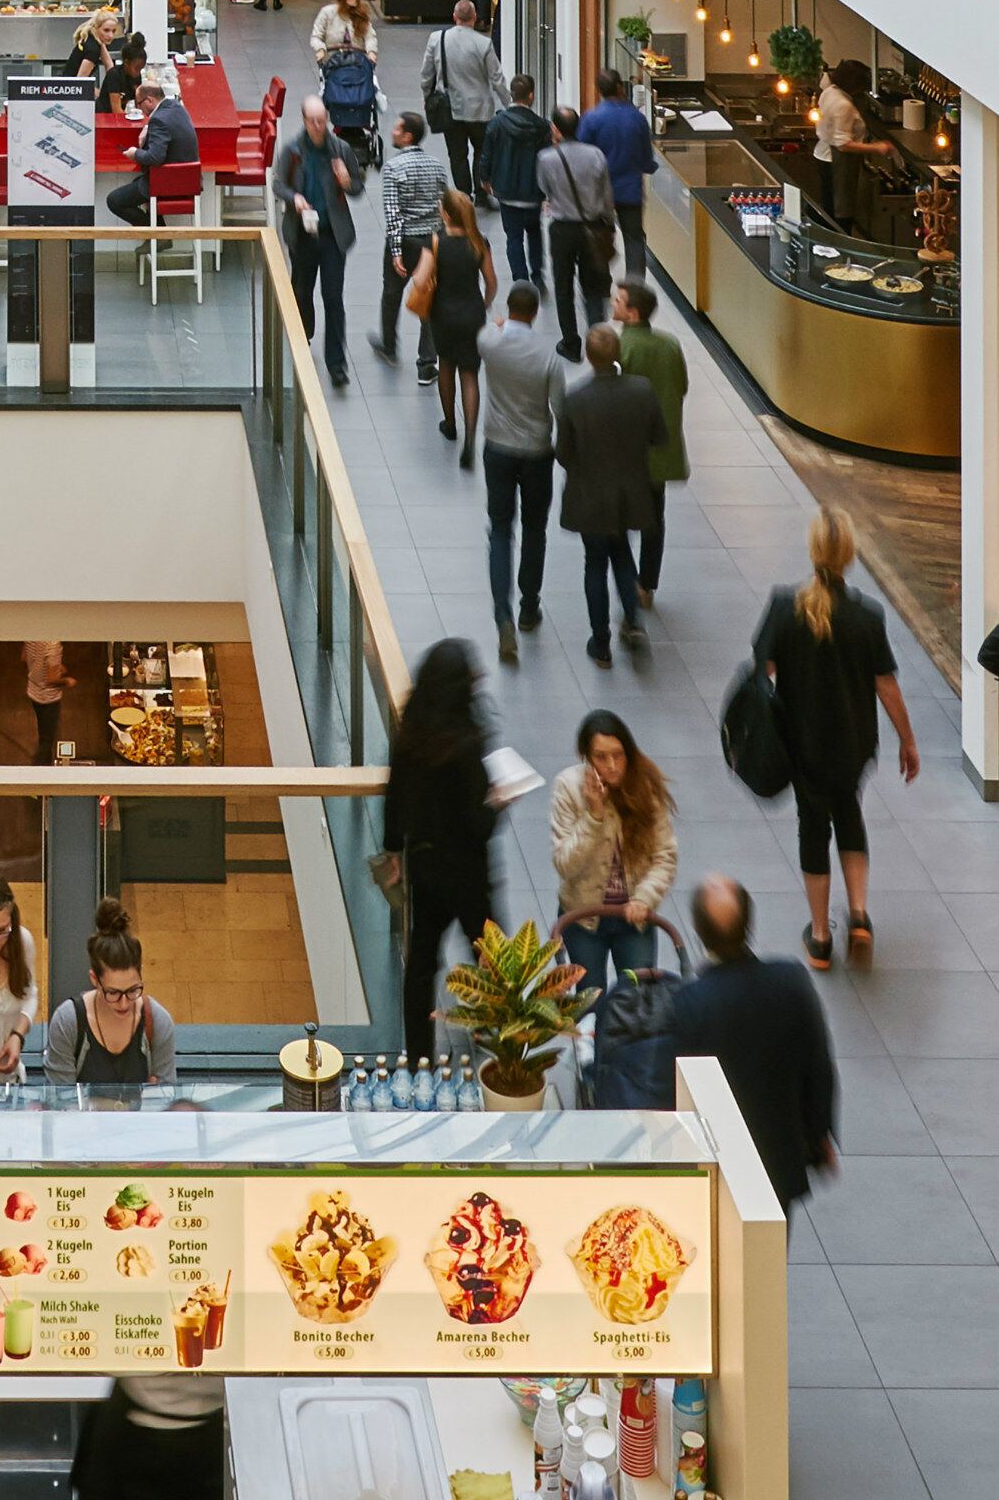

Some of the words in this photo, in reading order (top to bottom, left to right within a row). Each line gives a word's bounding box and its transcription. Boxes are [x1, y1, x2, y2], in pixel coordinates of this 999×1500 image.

[21, 86, 40, 95] RIEM
[42, 86, 83, 95] ARCADEN
[47, 1187, 52, 1198] 1
[56, 1187, 86, 1200] Kugel
[168, 1187, 174, 1198] 3
[177, 1187, 214, 1200] Kugeln
[57, 1201, 70, 1211] Eis
[178, 1201, 192, 1211] Eis
[47, 1240, 53, 1250] 2
[56, 1240, 93, 1253] Kugeln
[169, 1240, 207, 1250] Portion
[57, 1253, 71, 1264] Eis
[169, 1253, 201, 1264] Sahne
[40, 1300, 67, 1311] Milch
[70, 1300, 100, 1312] Shake
[59, 1316, 78, 1324] Wahl
[115, 1314, 162, 1325] Eisschoko
[115, 1328, 160, 1339] Eiskaffee
[294, 1330, 332, 1342] Bonito
[335, 1330, 374, 1342] Becher
[436, 1331, 487, 1342] Amarena
[491, 1331, 530, 1342] Becher
[593, 1331, 671, 1346] Spaghetti-Eis
